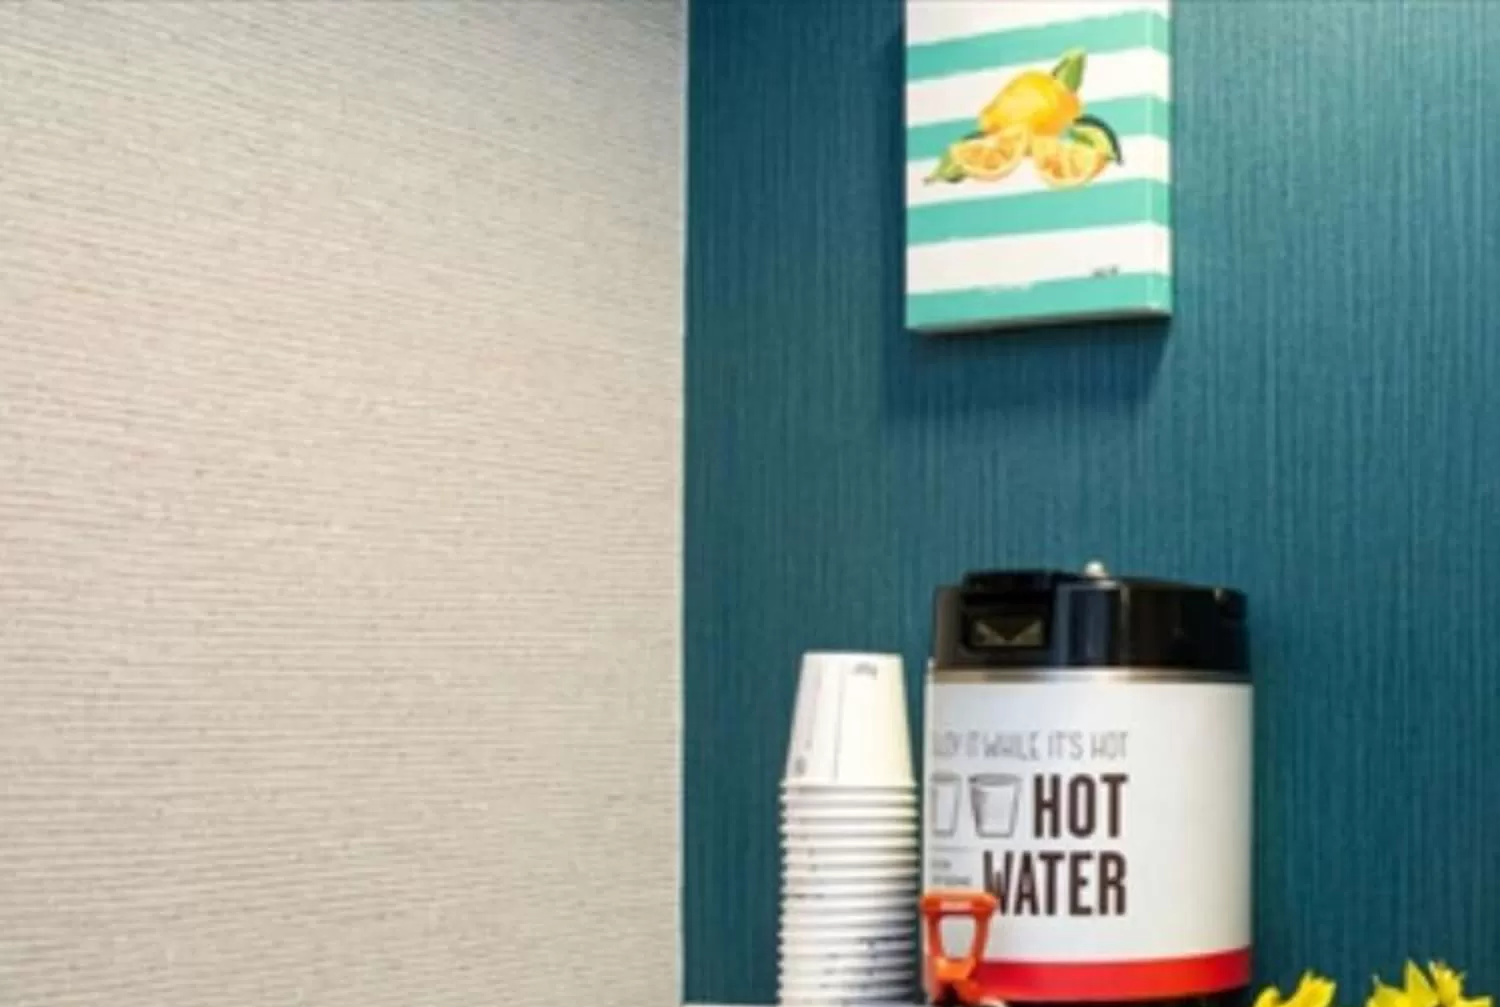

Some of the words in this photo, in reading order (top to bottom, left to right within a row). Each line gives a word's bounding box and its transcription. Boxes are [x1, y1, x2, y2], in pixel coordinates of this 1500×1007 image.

[1047, 731, 1084, 761] IT'S
[1090, 731, 1128, 761] HOT
[1034, 773, 1129, 839] HOT
[983, 850, 1128, 917] WATER
